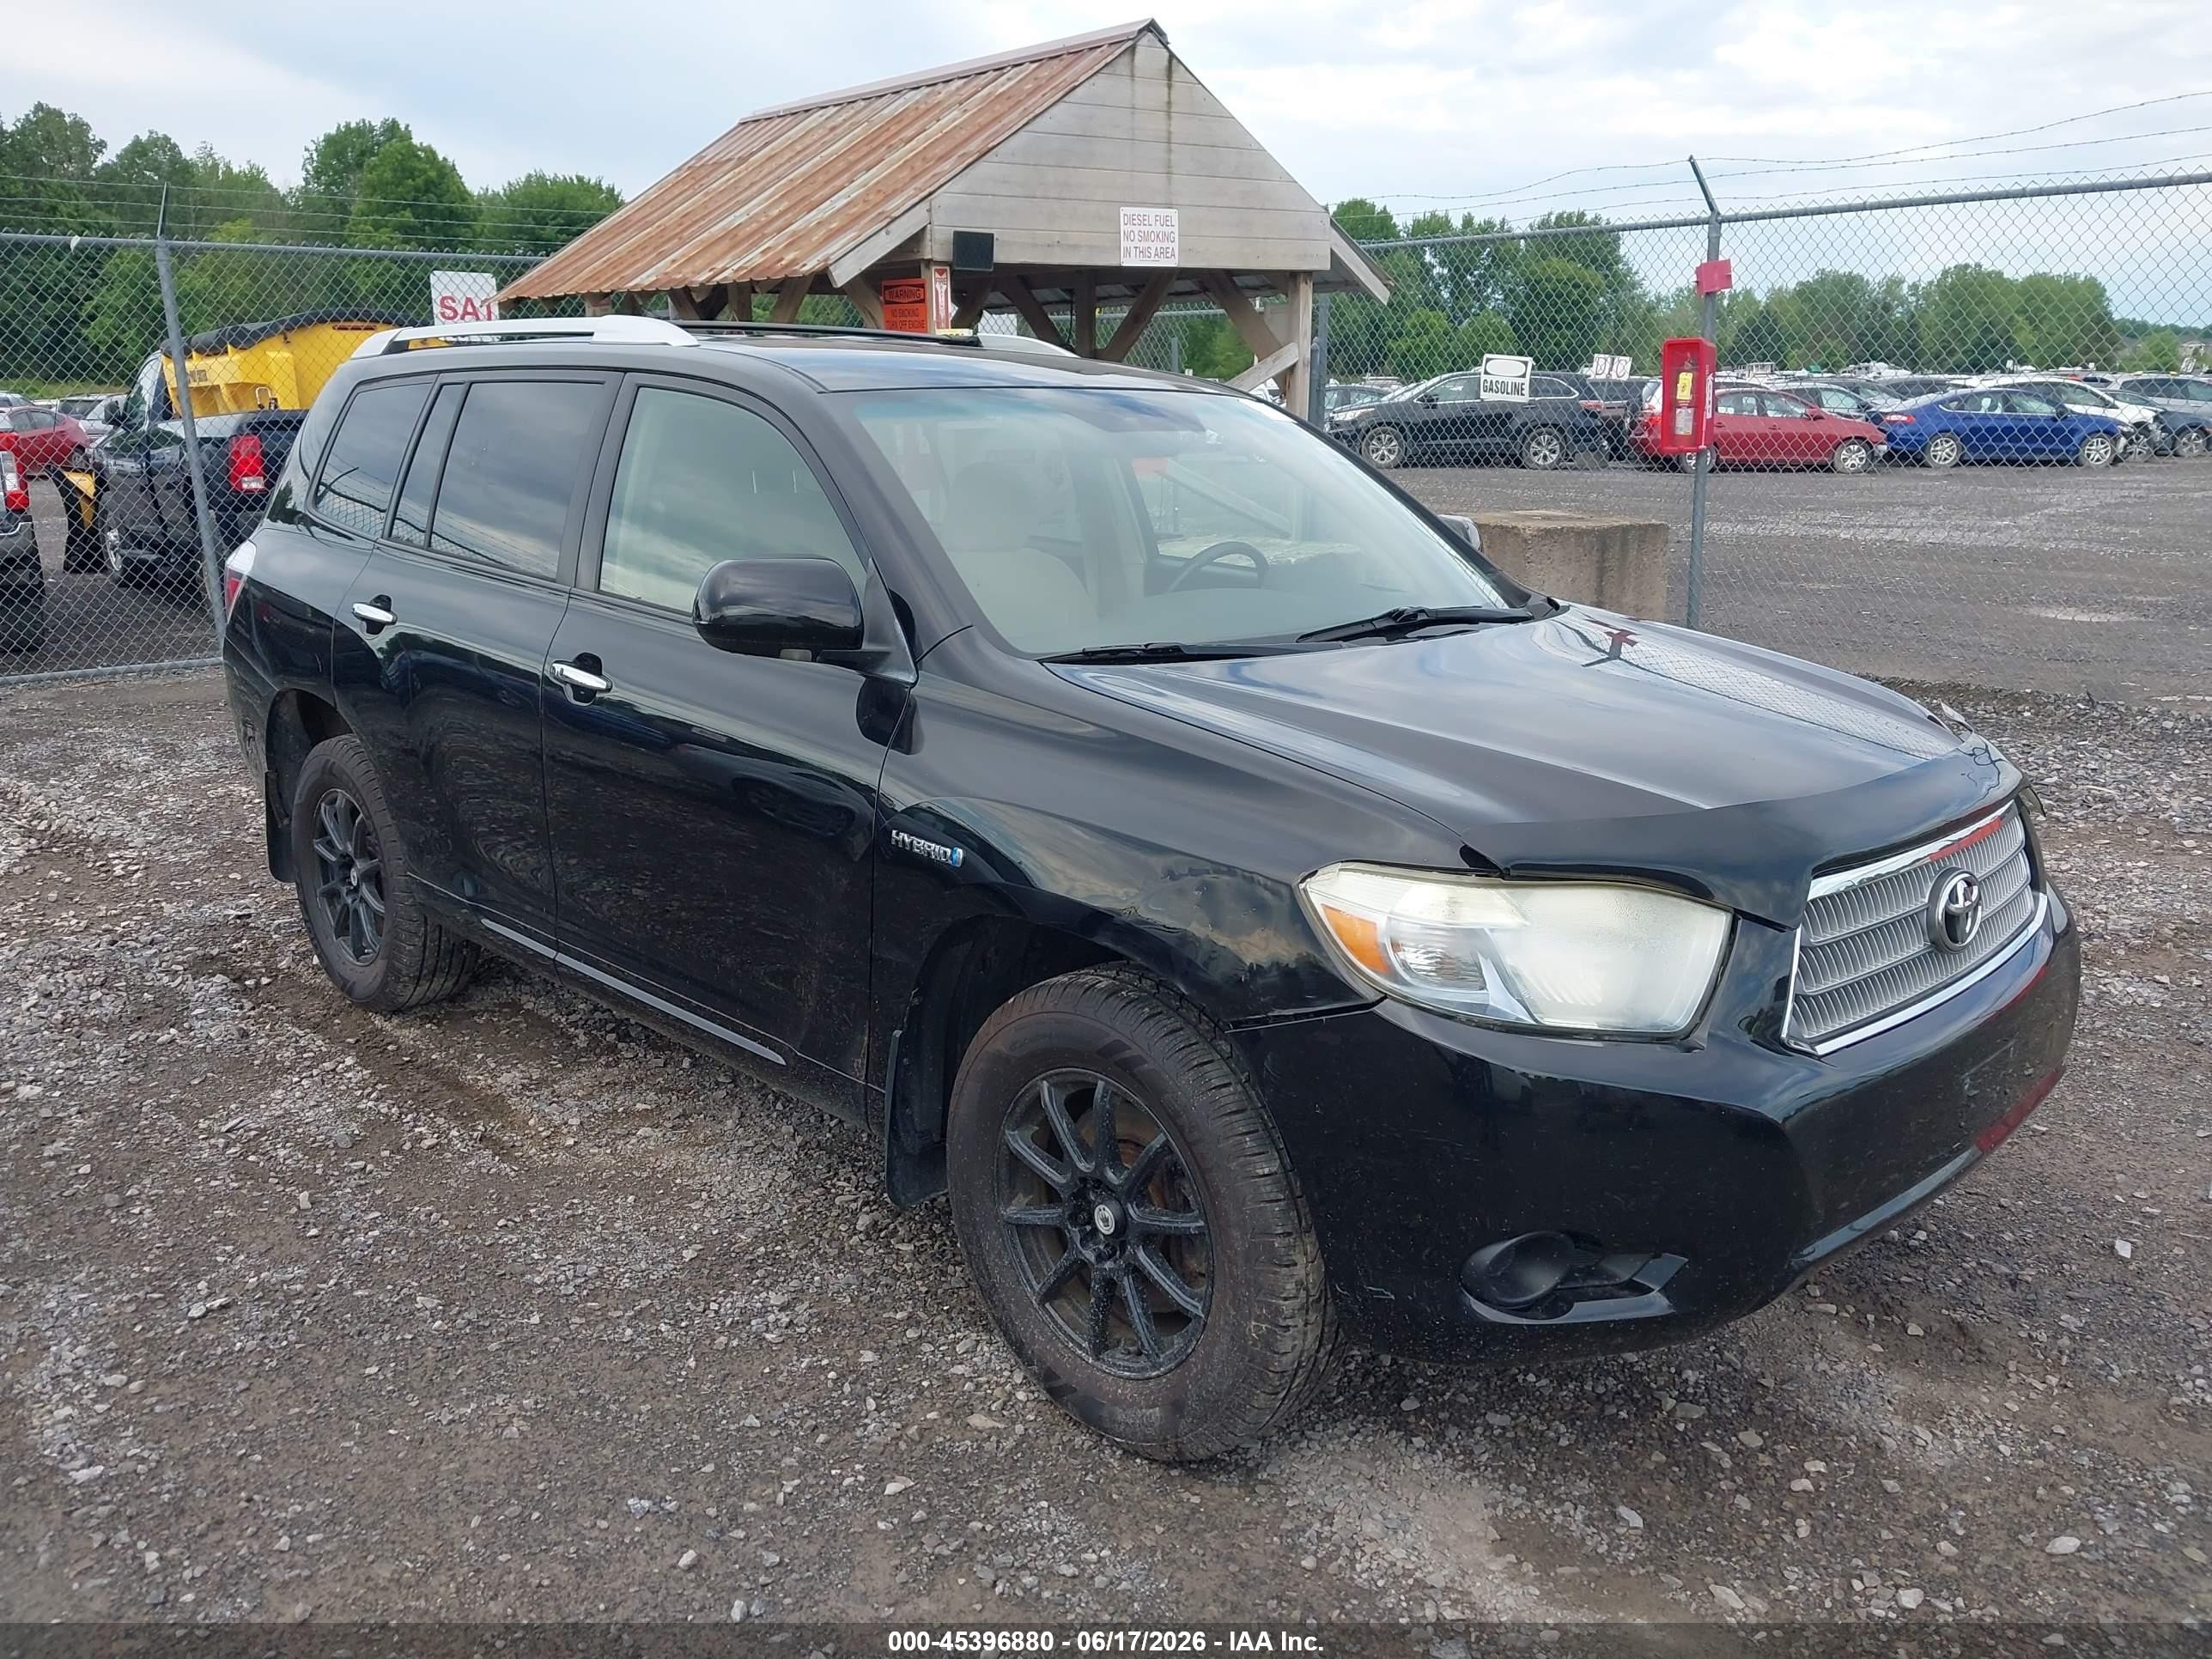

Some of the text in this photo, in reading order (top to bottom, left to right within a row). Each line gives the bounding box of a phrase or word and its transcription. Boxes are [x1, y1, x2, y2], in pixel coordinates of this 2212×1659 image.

[1123, 213, 1176, 227] DIESEL FUEL
[1123, 229, 1176, 244] NO SMOKING
[1123, 246, 1176, 259] IN THIS AREA
[888, 289, 921, 300] WARNING
[1482, 379, 1526, 397] GASOLINE
[890, 829, 951, 863] HYBRID
